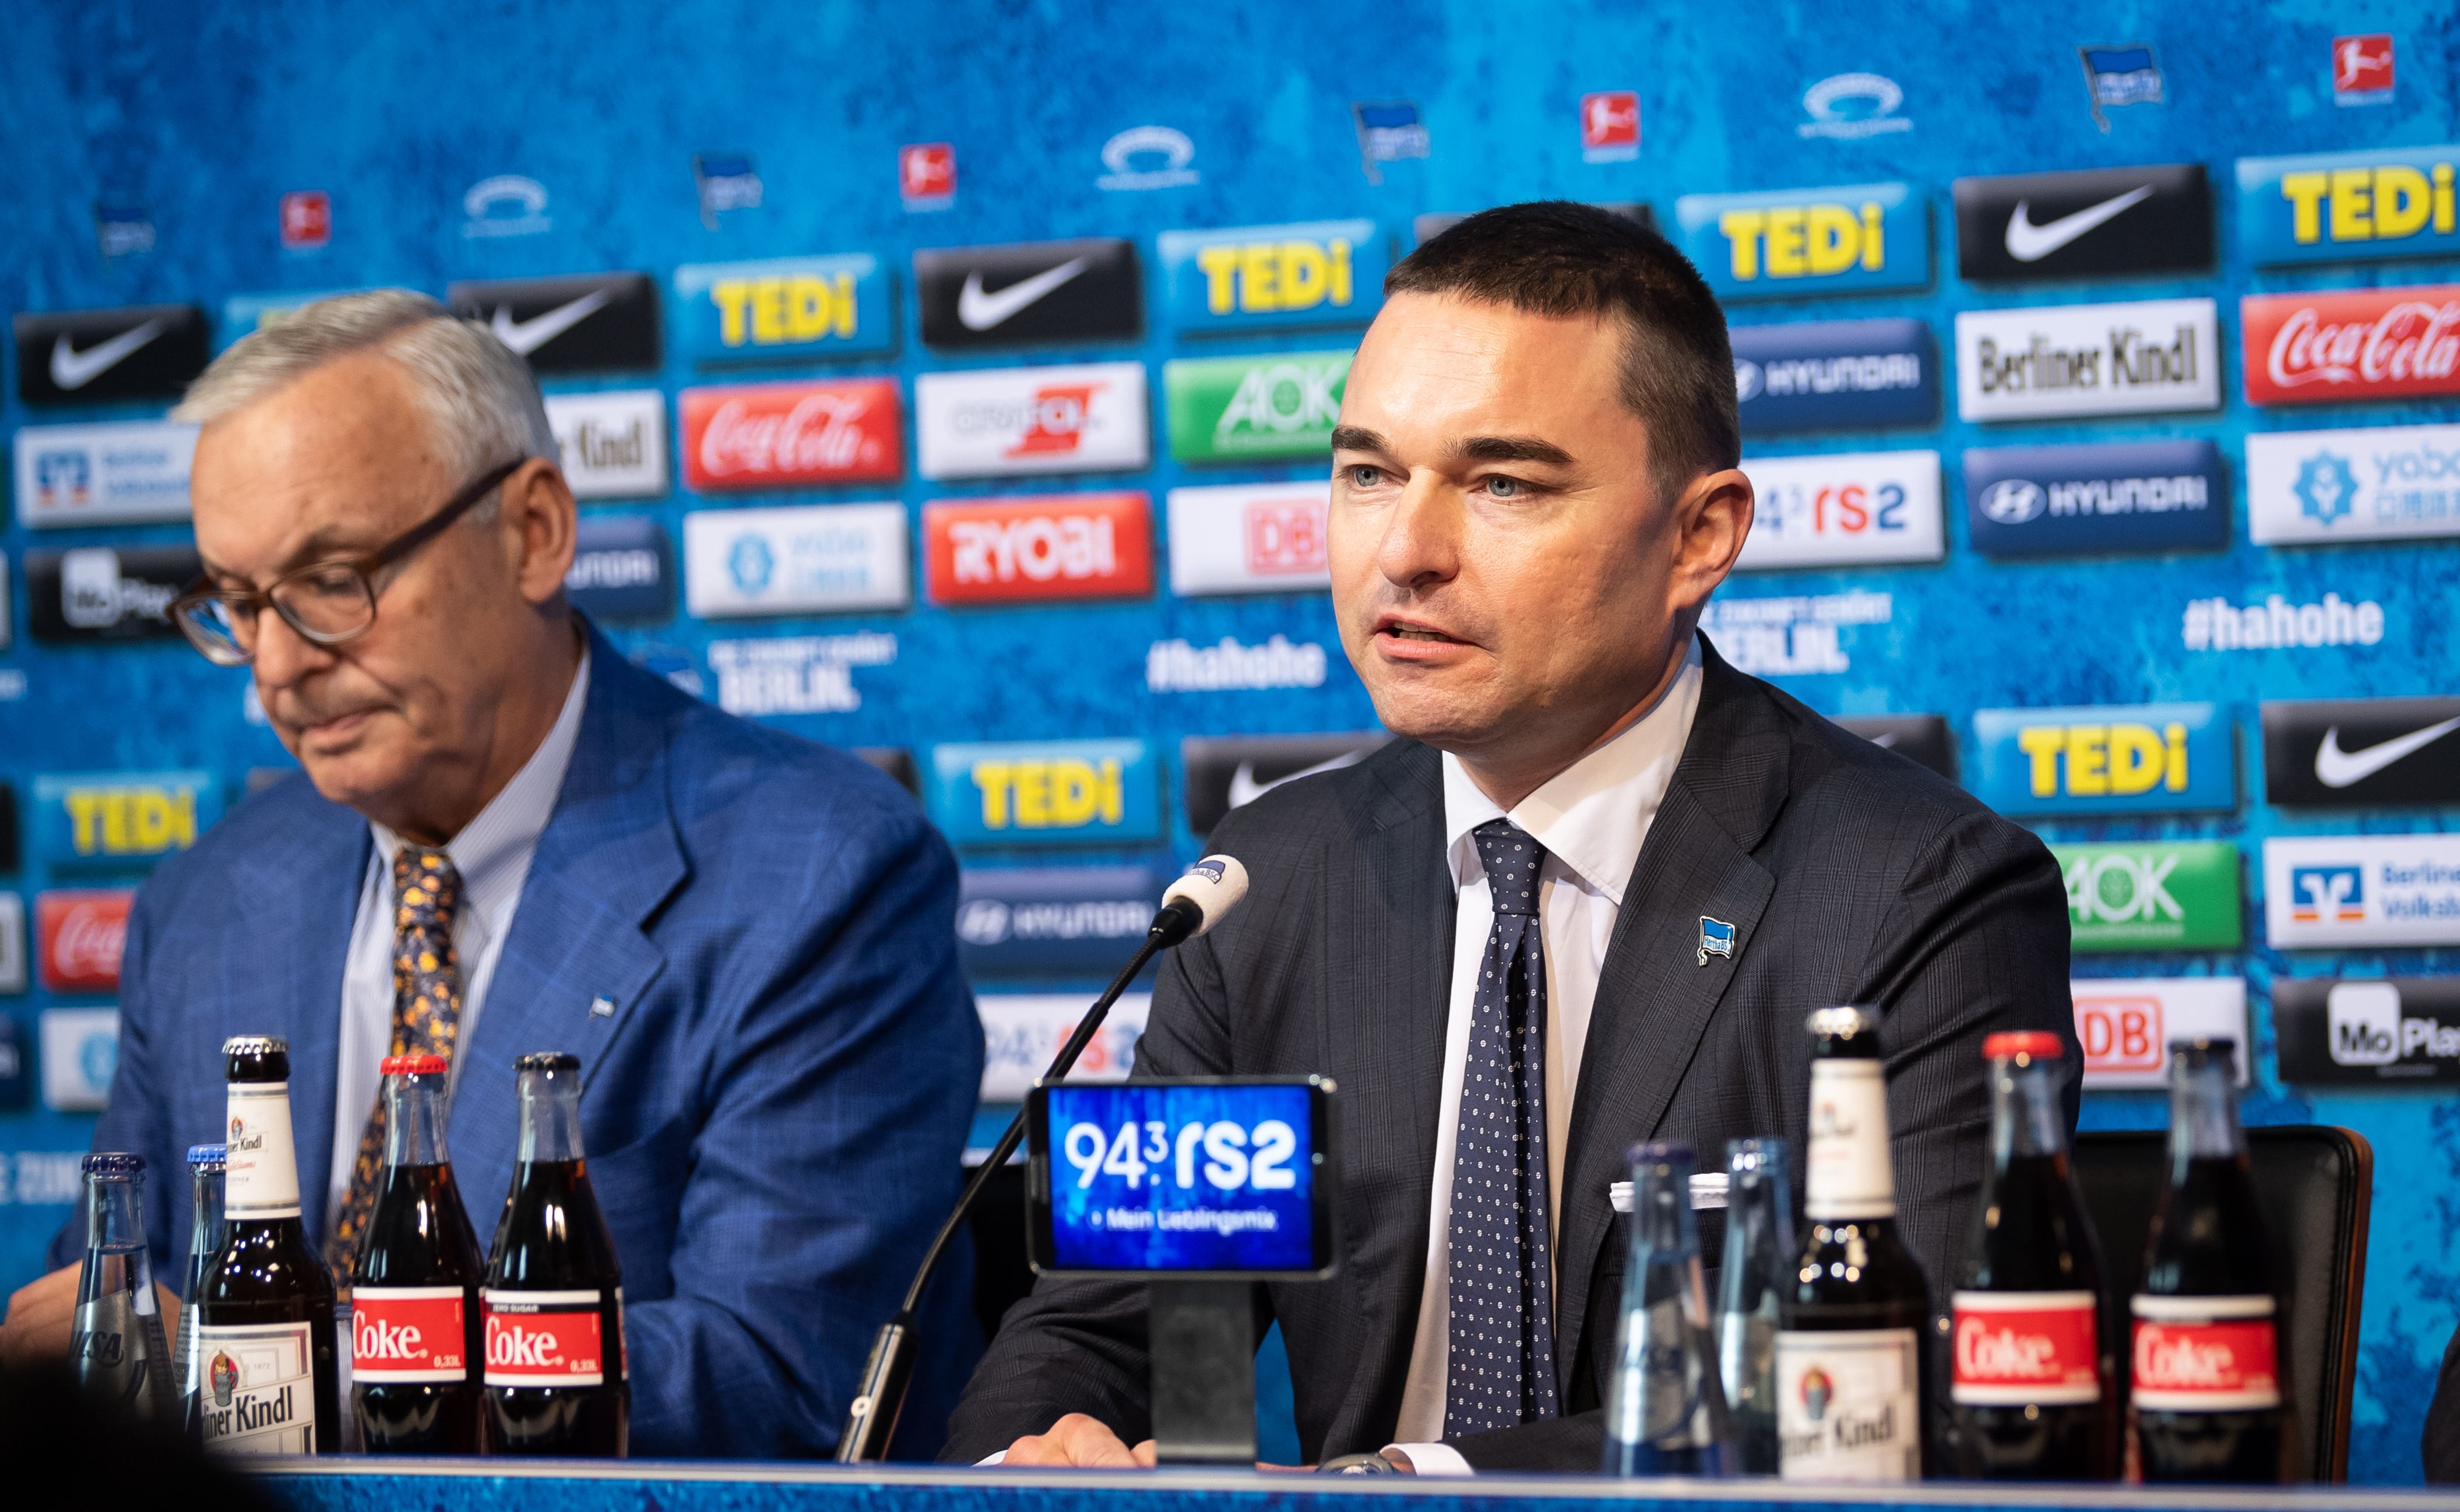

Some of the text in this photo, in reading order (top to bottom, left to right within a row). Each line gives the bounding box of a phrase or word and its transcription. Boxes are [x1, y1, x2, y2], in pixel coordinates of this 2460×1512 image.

[2281, 164, 2456, 245] TEDi
[1720, 202, 1885, 281] TEDi
[710, 274, 858, 347] TEDi
[1198, 238, 1353, 315] TEDi
[1763, 352, 1921, 397] HYUNDAI
[1978, 320, 2197, 395] Berliner Kindl
[1216, 362, 1344, 434] AOK
[2049, 475, 2208, 517] HYUNDAI
[949, 514, 1115, 584] RYOBI
[2182, 591, 2384, 651] #hahohe
[1145, 634, 1326, 693] #hahohe
[971, 756, 1124, 830] TEDi
[2017, 722, 2188, 798] TEDi
[63, 787, 198, 855] TEDi
[2068, 854, 2184, 922] AOK
[2380, 891, 2460, 920] Volksb
[2381, 859, 2460, 886] Berline
[2082, 1010, 2150, 1058] DB
[240, 1135, 262, 1152] Kindl
[1174, 1119, 1297, 1190] rs2
[510, 1304, 539, 1313] SUGAR
[235, 1385, 294, 1433] Kindl
